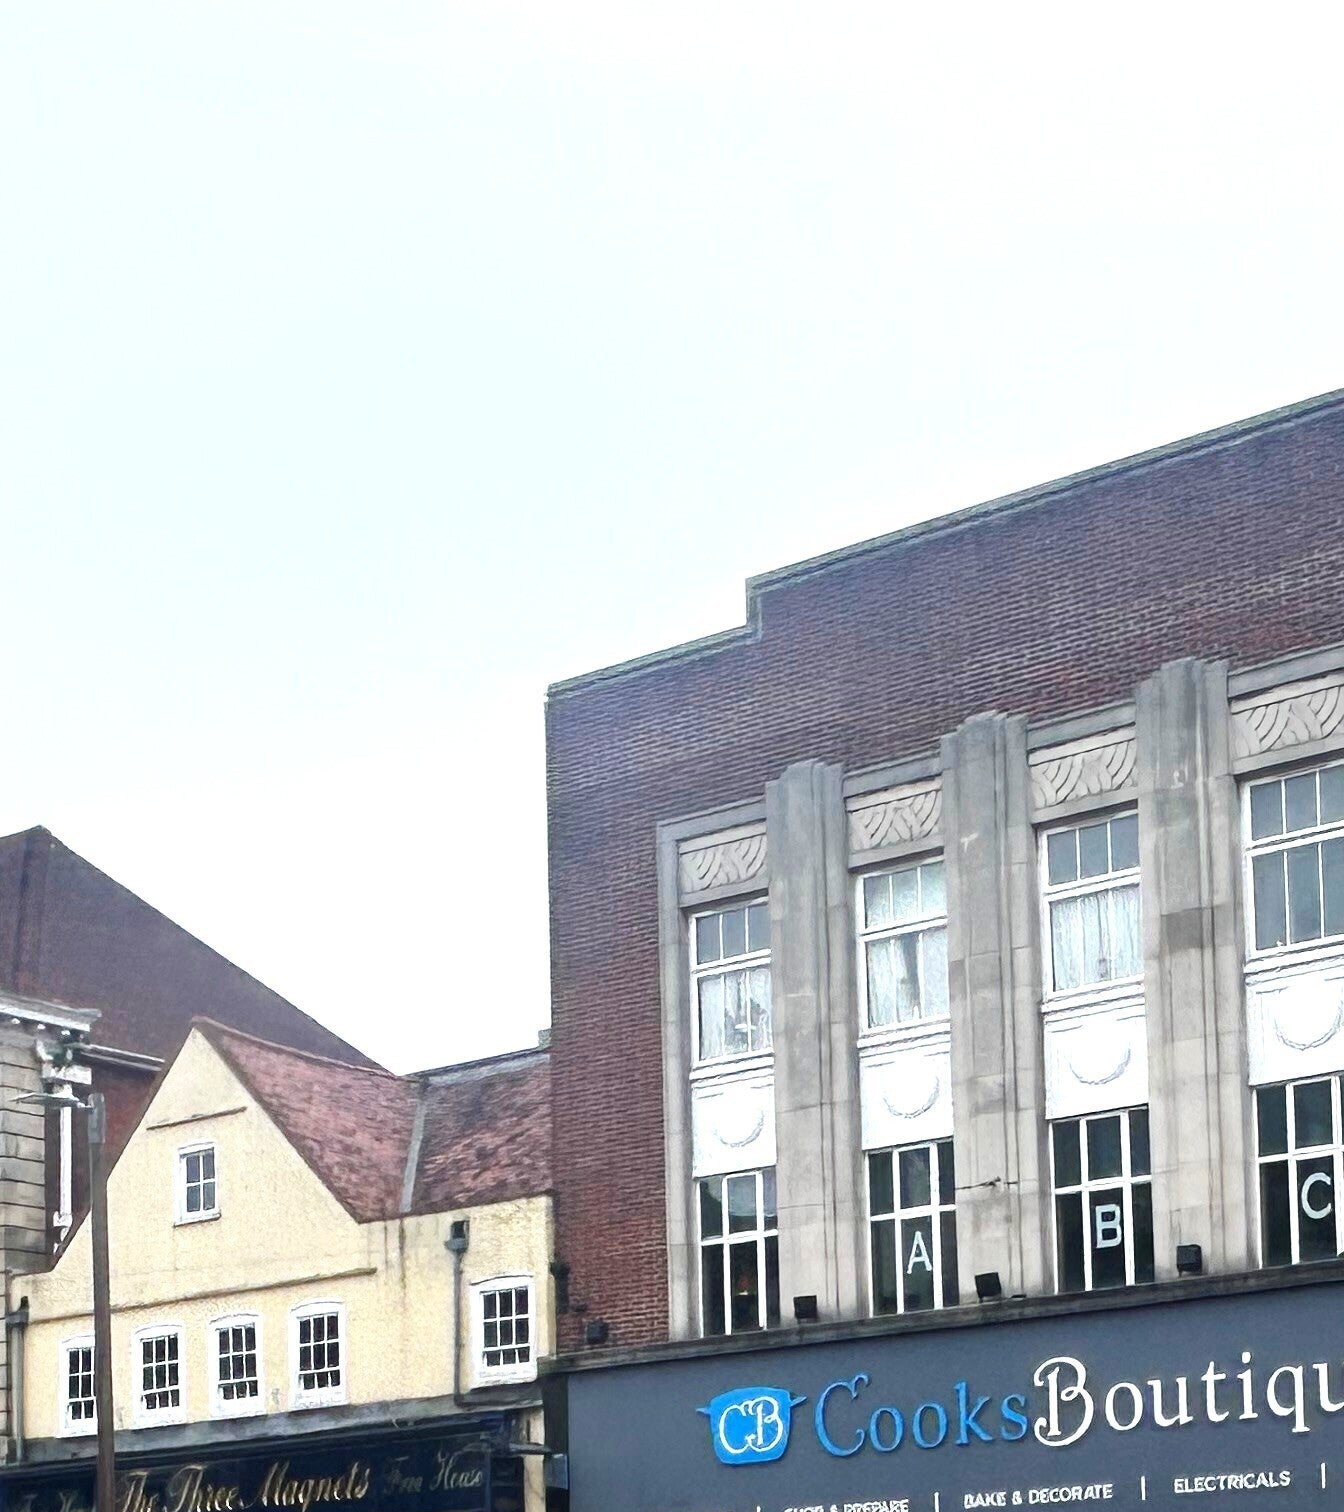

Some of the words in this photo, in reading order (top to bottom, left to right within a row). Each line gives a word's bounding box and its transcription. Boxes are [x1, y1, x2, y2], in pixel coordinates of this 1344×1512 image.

[1300, 1172, 1332, 1220] C
[1095, 1203, 1122, 1249] B
[907, 1231, 933, 1275] A
[964, 1491, 1007, 1510] BAKE
[1028, 1482, 1114, 1505] DECORATE
[1174, 1470, 1292, 1494] ELECTRICALS
